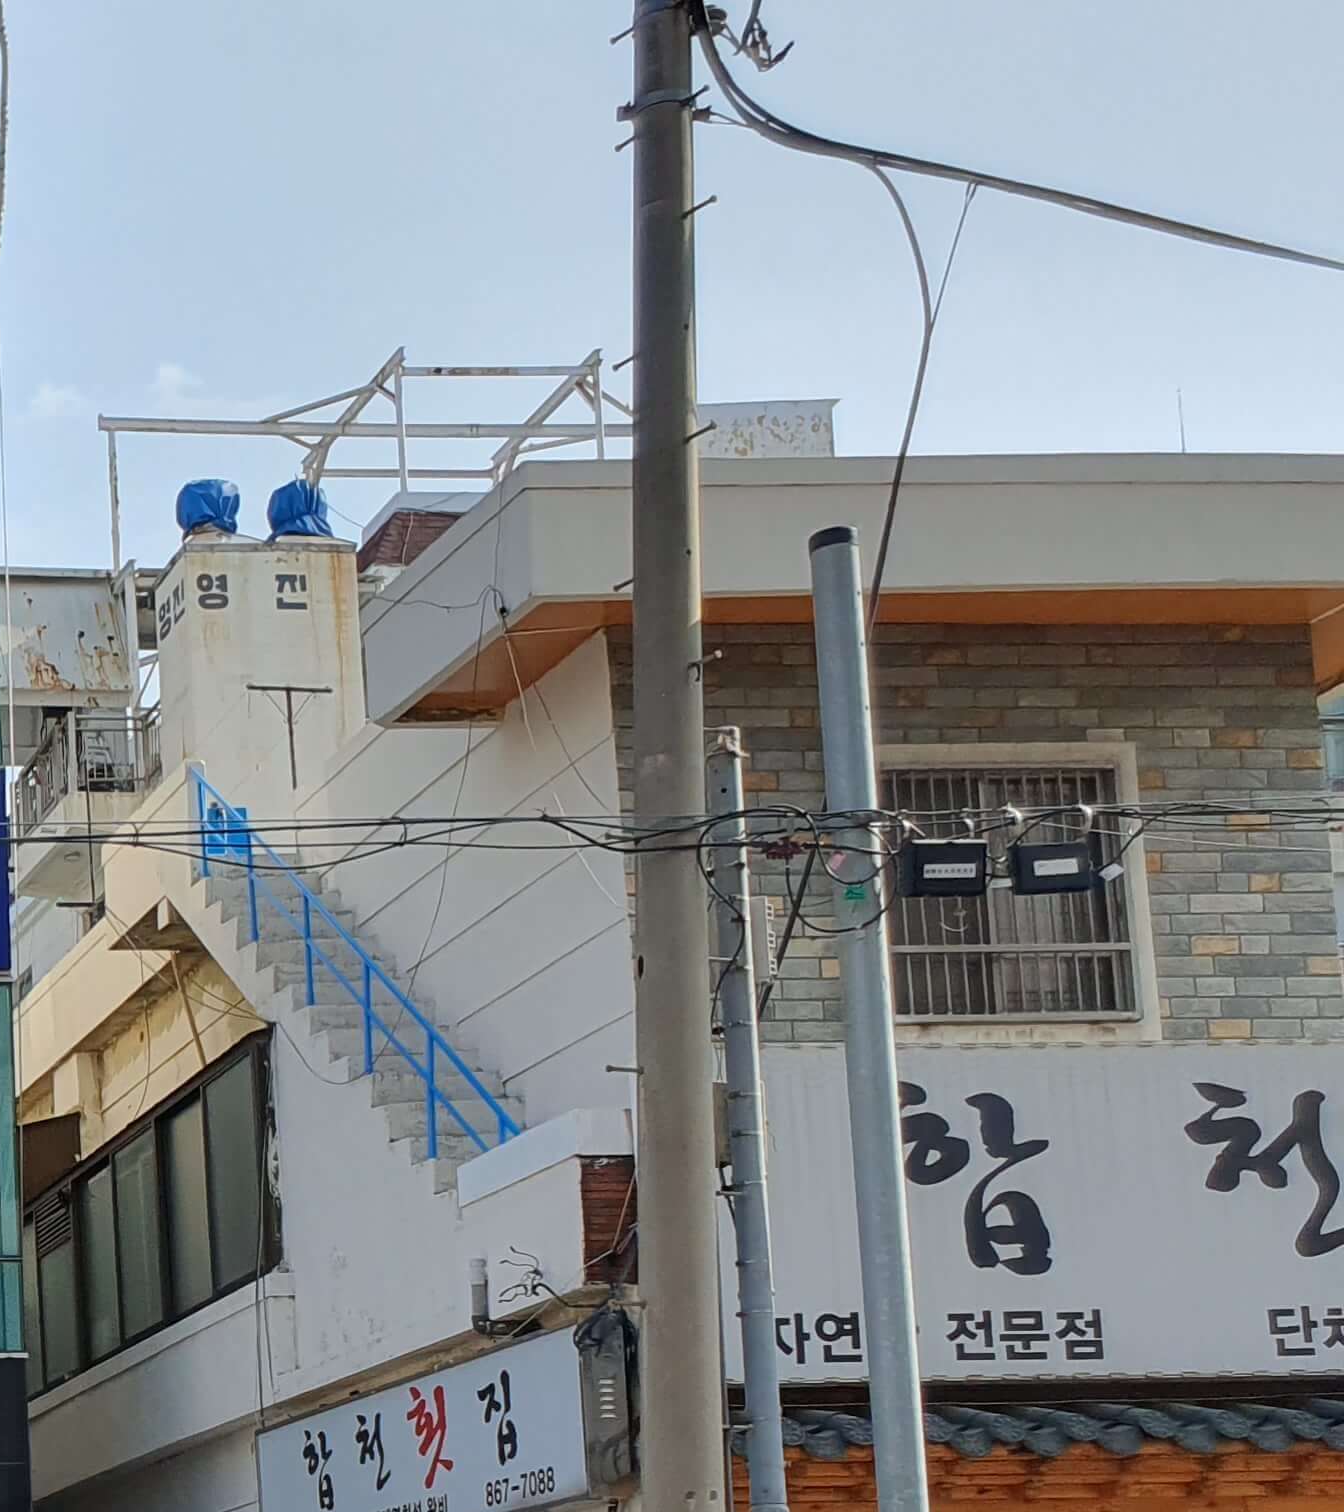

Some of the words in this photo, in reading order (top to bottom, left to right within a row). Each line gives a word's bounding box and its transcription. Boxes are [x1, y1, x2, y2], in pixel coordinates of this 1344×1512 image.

[196, 573, 308, 611] 영진
[946, 1308, 1105, 1361] 전문점
[485, 1466, 556, 1507] 867-7088
